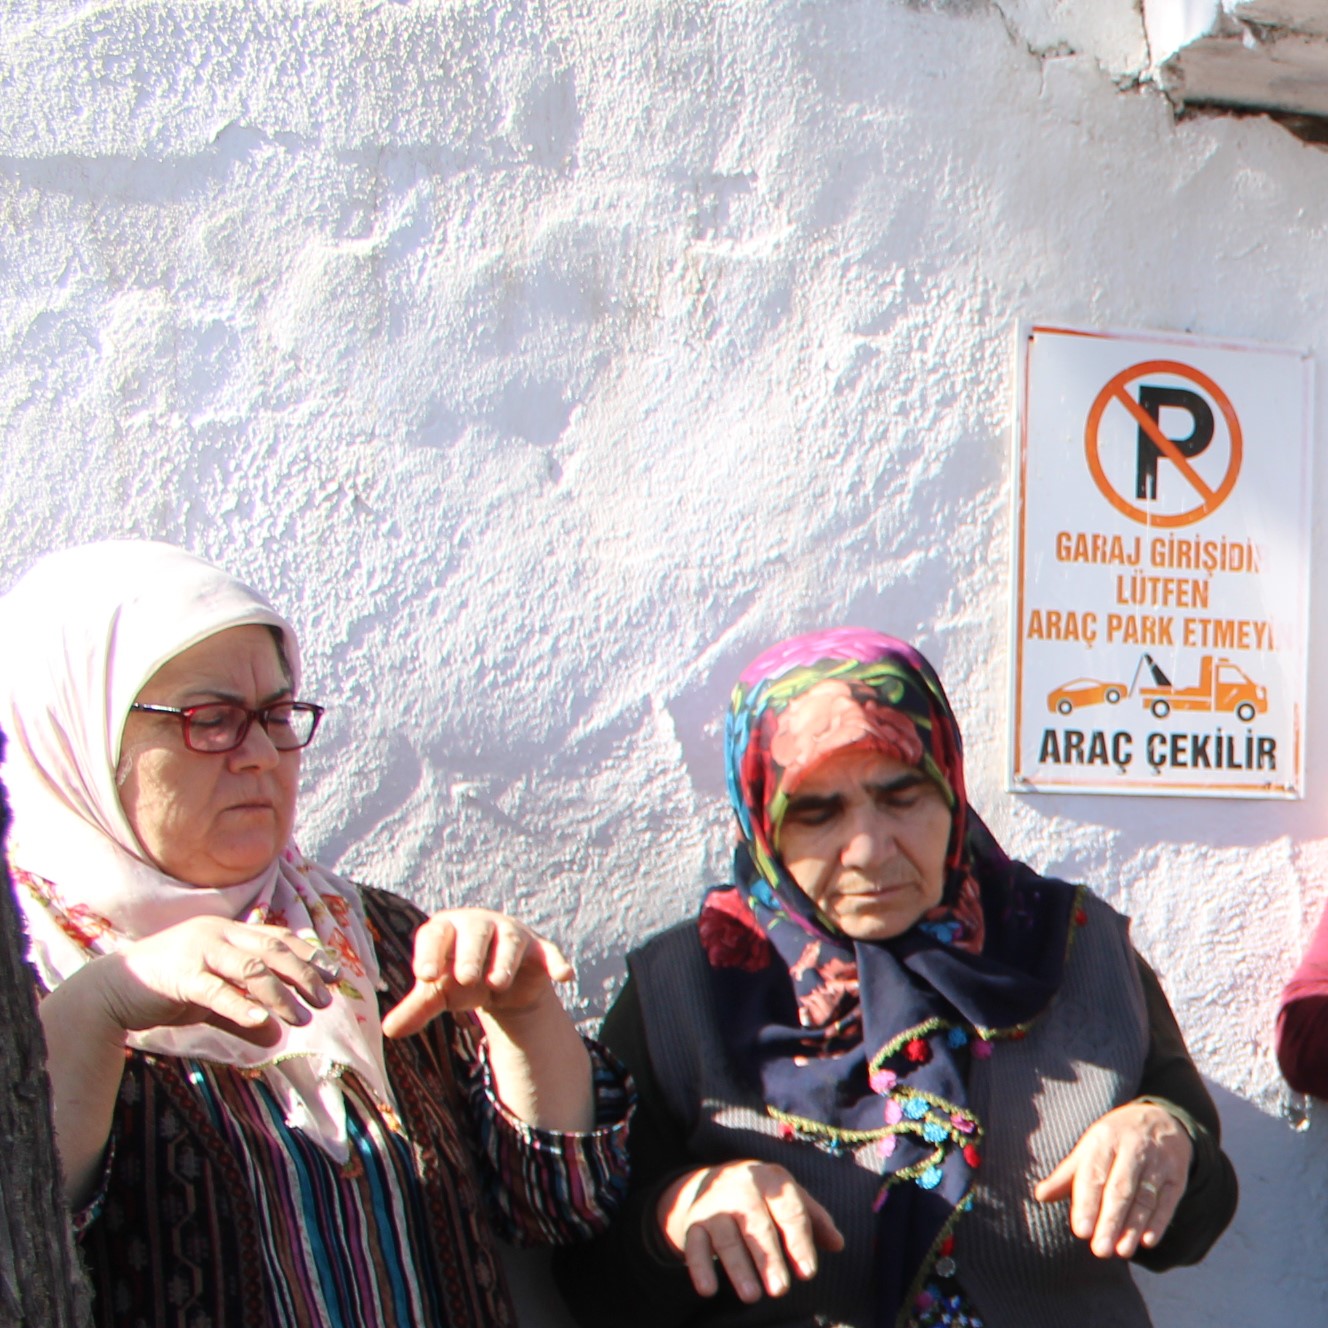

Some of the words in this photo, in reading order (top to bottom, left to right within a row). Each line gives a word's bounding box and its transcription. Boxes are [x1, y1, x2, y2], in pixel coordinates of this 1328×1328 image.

[1136, 384, 1215, 501] P
[1055, 530, 1142, 567] GARAJ
[1116, 568, 1210, 609] LÜTFEN
[1027, 609, 1097, 649] ARAÇ
[1106, 613, 1174, 647] PARK
[1038, 728, 1133, 775] ARAÇ
[1146, 727, 1278, 776] ÇEKİLİR
